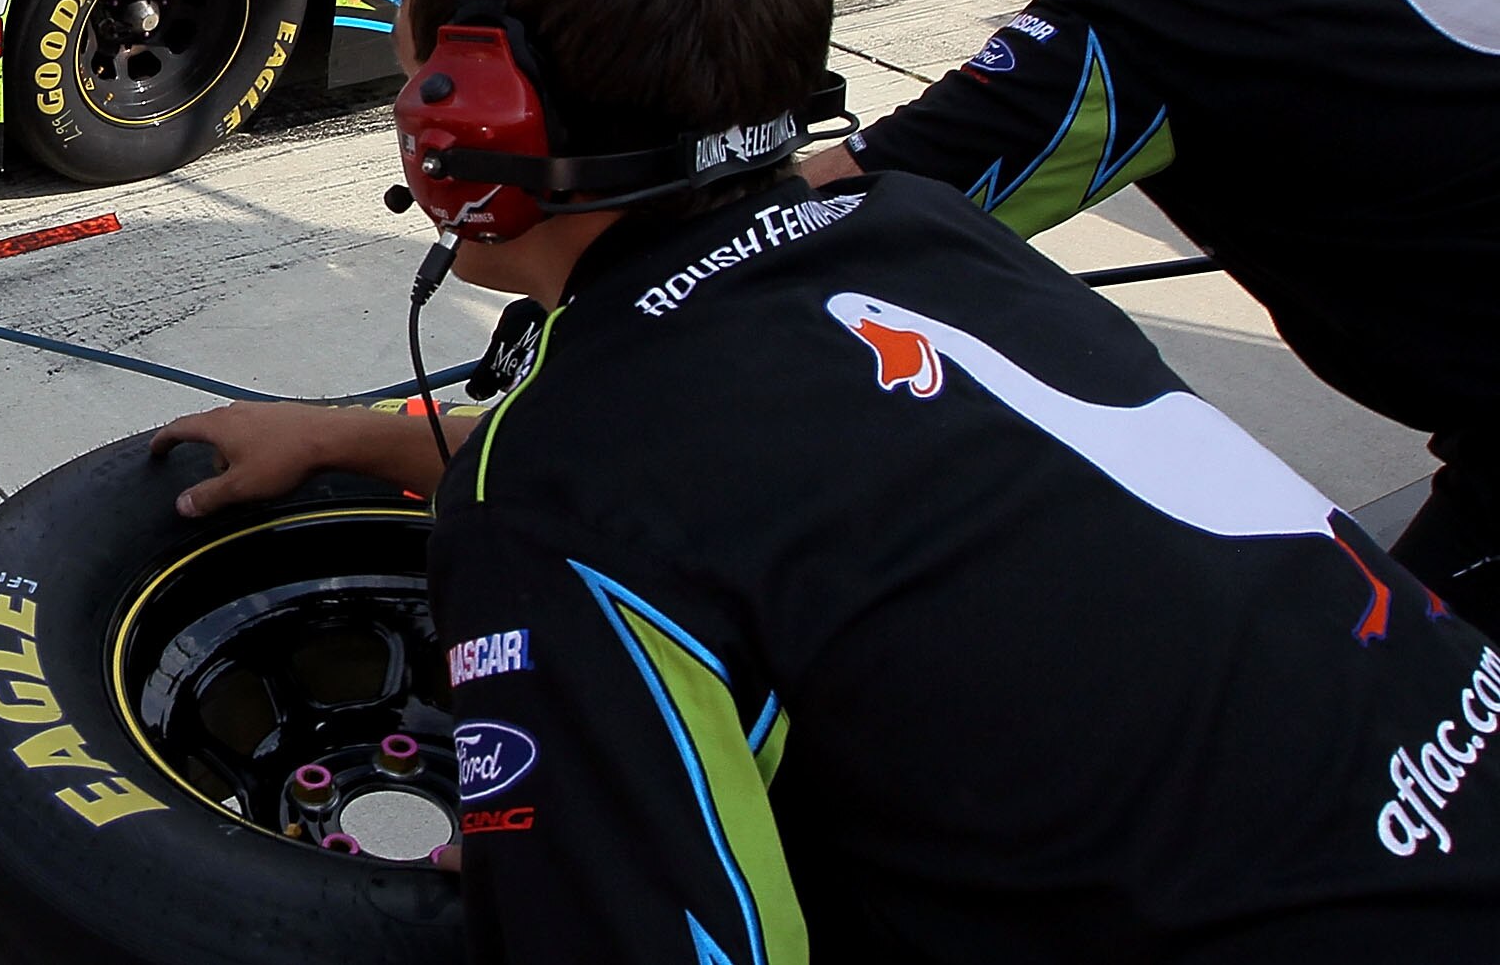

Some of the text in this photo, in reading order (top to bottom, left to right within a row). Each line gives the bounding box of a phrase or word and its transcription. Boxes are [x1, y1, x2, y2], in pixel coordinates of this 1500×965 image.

[221, 19, 299, 136] EAGLE
[449, 630, 524, 687] NASCAR
[455, 734, 503, 786] Ford
